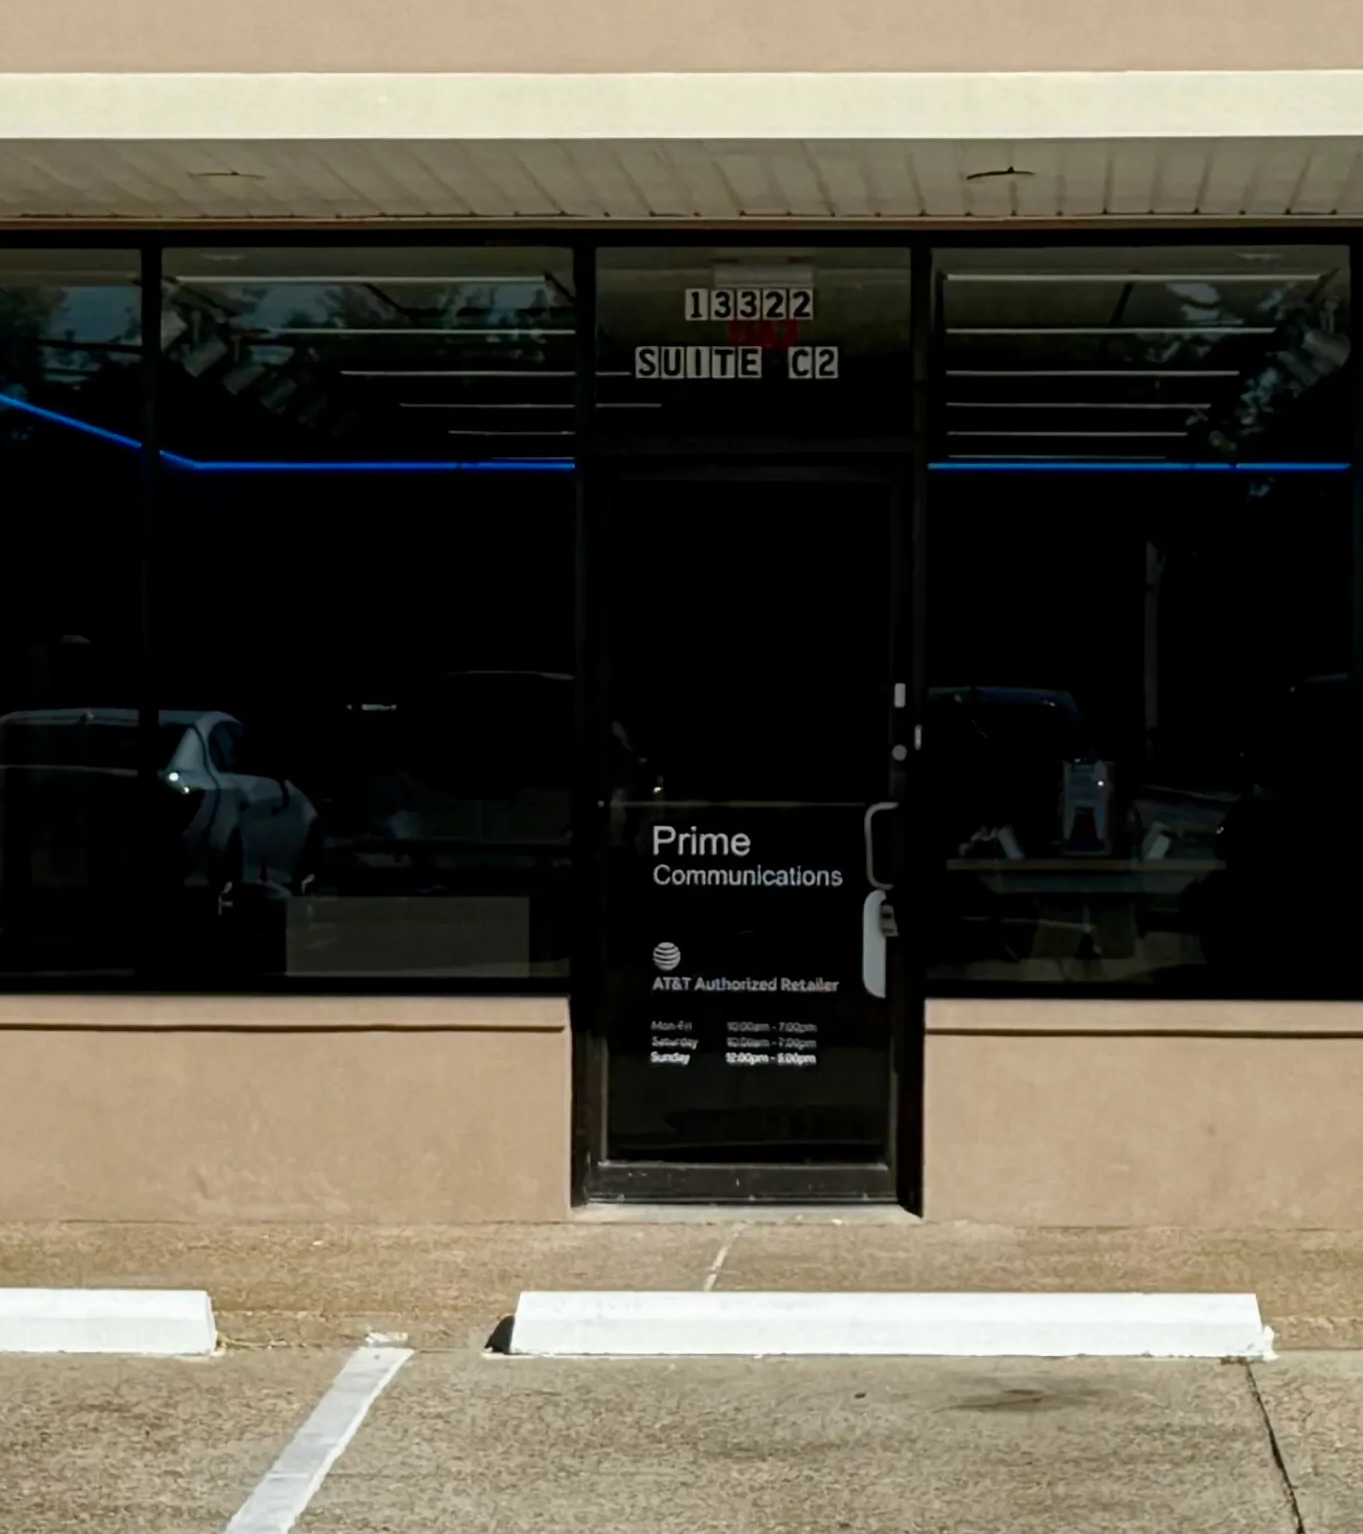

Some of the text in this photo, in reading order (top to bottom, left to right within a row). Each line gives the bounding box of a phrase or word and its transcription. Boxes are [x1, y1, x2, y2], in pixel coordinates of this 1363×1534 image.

[687, 288, 813, 320] 13322
[637, 347, 838, 378] SUITE C2
[653, 826, 751, 856] Prime
[653, 864, 843, 886] Communications
[652, 976, 840, 992] AT&T Authorized Retailer
[650, 1051, 691, 1066] Sunday
